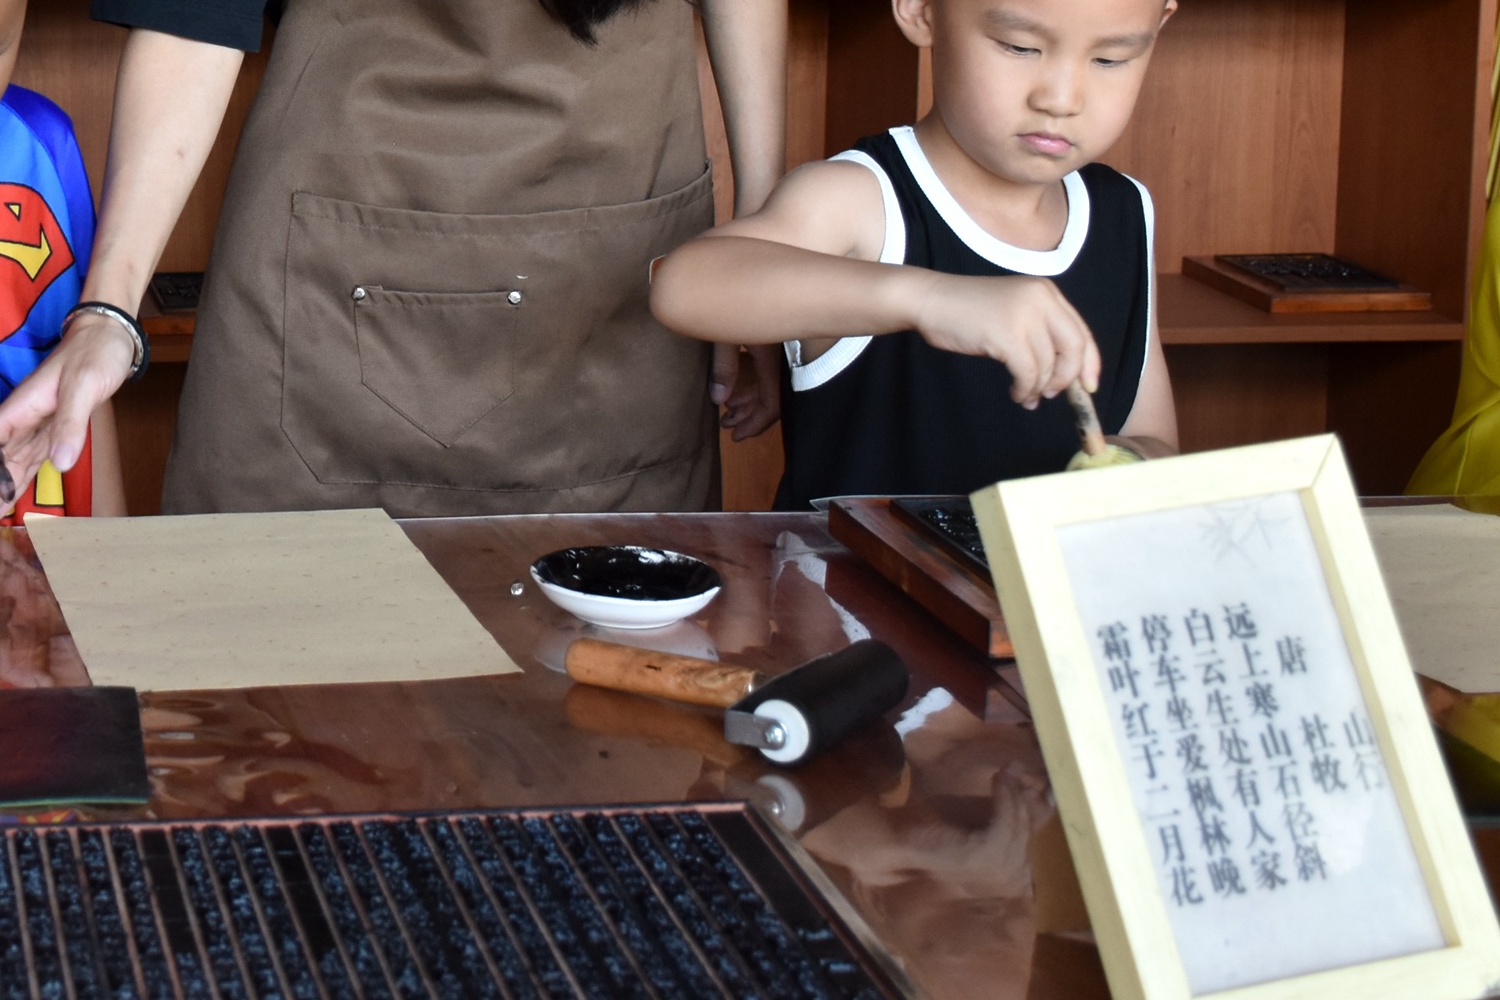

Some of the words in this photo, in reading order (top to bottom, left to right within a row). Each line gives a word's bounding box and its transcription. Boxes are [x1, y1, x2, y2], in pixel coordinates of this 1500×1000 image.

[1096, 621, 1206, 908] 霜叶红于二月花
[1140, 613, 1248, 899] 停车坐爱枫林晚
[1183, 607, 1289, 892] 白云生处有人家
[1222, 601, 1328, 882] 远上寒山石径斜
[1274, 634, 1309, 677] 唐
[1298, 712, 1348, 795] 杜牧
[1342, 711, 1389, 792] 山行
